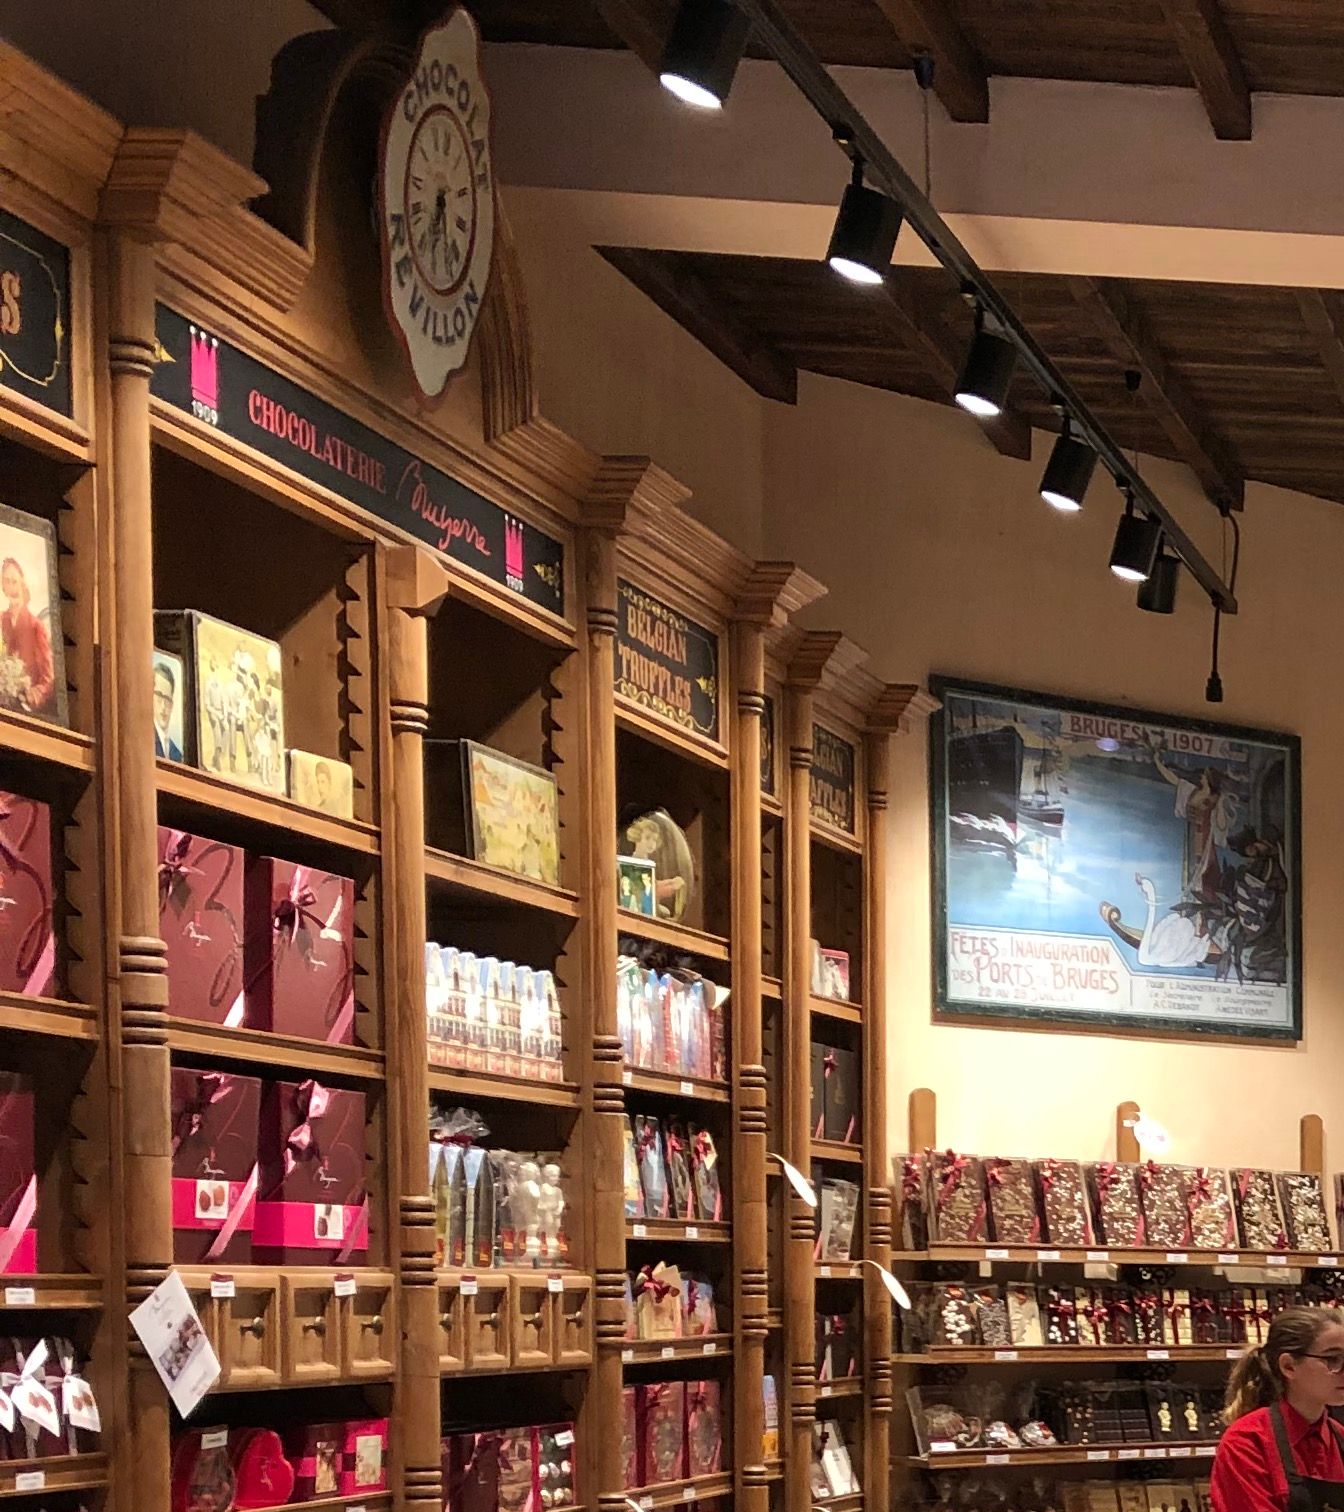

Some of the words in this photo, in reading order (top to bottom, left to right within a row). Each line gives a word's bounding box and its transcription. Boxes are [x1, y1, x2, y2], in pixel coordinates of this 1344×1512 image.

[403, 60, 489, 194] CHOCOLAT
[191, 399, 219, 426] 1909
[248, 389, 387, 495] CHOCOLATERIE
[627, 604, 688, 667] BELGIAN
[618, 640, 692, 714] TRUFFLES
[1070, 714, 1142, 742] BRUGES
[1172, 732, 1214, 755] 1907
[973, 956, 1034, 988] PORTS
[1051, 962, 1120, 994] BRUGES
[1010, 935, 1111, 965] INAUGURATION
